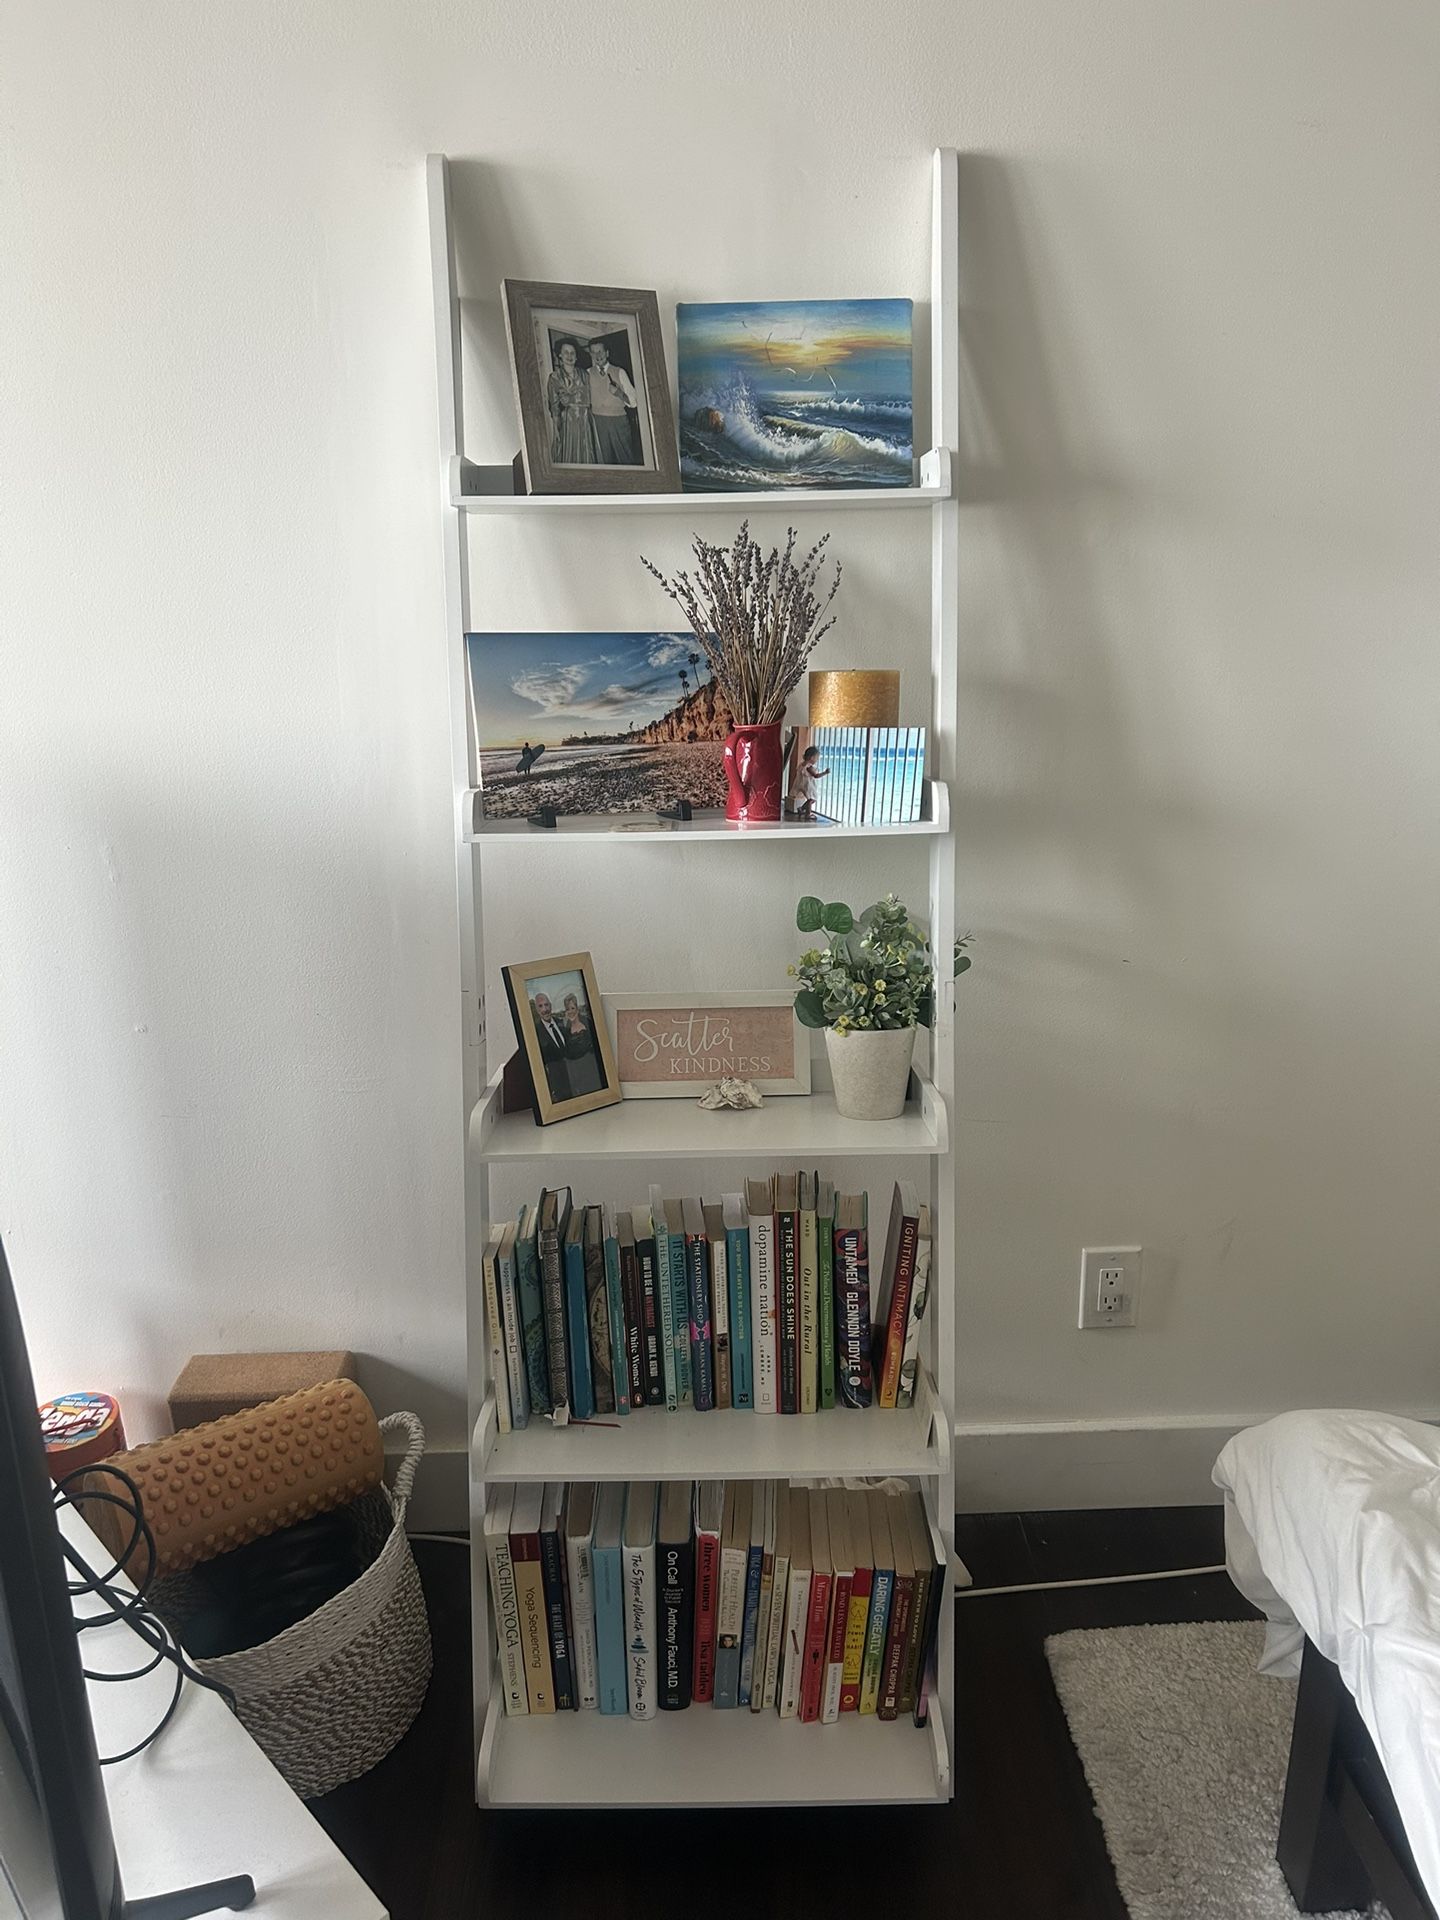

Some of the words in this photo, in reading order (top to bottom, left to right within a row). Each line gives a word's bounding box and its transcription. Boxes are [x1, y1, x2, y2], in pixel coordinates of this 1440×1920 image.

[634, 1011, 734, 1062] Scatter
[670, 1056, 771, 1074] KINDNESS
[659, 1239, 668, 1258] THE
[672, 1240, 682, 1249] IT
[754, 1224, 771, 1290] dopamine
[900, 1223, 914, 1275] IGNITING
[642, 1256, 652, 1271] HOW
[674, 1252, 686, 1287] STARTS
[786, 1252, 794, 1273] SUN
[845, 1238, 860, 1284] UNTAMED
[644, 1272, 652, 1280] TO
[694, 1258, 703, 1302] STATIONERY
[804, 1268, 812, 1286] Out
[822, 1270, 830, 1296] Political
[644, 1288, 653, 1296] AN
[661, 1262, 671, 1333] UNTETHERED
[786, 1276, 794, 1304] DOES
[804, 1290, 812, 1301] in
[676, 1291, 688, 1315] WITH
[696, 1304, 704, 1325] SHOP
[760, 1294, 773, 1337] nation
[804, 1304, 812, 1321] the
[846, 1292, 860, 1337] GLENNON
[893, 1280, 908, 1336] INTIMACY
[678, 1317, 688, 1331] US
[787, 1308, 795, 1340] SHINE
[508, 1332, 516, 1343] job
[630, 1326, 640, 1353] White
[665, 1334, 673, 1361] SOUL
[678, 1334, 689, 1361] COLLEEN
[804, 1324, 812, 1355] Rural
[720, 1353, 728, 1371] Wayne
[848, 1340, 861, 1370] DOYLE
[632, 1355, 641, 1387] Women
[632, 1554, 642, 1568] The
[668, 1551, 678, 1566] On
[704, 1542, 714, 1572] three
[496, 1544, 515, 1610] TEACHING
[632, 1568, 644, 1576] 5
[668, 1567, 678, 1584] Call
[630, 1576, 643, 1597] Types
[702, 1574, 710, 1612] women
[814, 1581, 826, 1602] Marry
[874, 1576, 888, 1612] DARING
[524, 1587, 537, 1612] Yoga
[551, 1604, 562, 1614] THE
[774, 1591, 782, 1611] SEVEN
[839, 1592, 847, 1610] ROAD
[552, 1615, 563, 1631] HEART
[632, 1604, 644, 1632] Wealth
[666, 1607, 678, 1644] Anthony
[728, 1600, 738, 1630] HEALTH
[772, 1612, 781, 1642] SPIRITUAL
[914, 1615, 920, 1623] TO
[502, 1608, 519, 1648] YOGA
[870, 1614, 884, 1655] GREATLY
[912, 1624, 920, 1644] LOVE
[528, 1614, 543, 1668] Sequencing
[555, 1640, 566, 1659] YOGA
[700, 1640, 710, 1659] lisa
[770, 1643, 779, 1660] LAWS
[834, 1626, 843, 1659] TRAVELED
[666, 1646, 678, 1670] Fauci,
[890, 1644, 902, 1668] DEEPAK
[507, 1652, 518, 1686] STEPHENS
[668, 1670, 678, 1688] M.D.
[700, 1661, 710, 1696] taddeo
[767, 1666, 776, 1685] YOGA
[888, 1668, 900, 1694] CHOPRA
